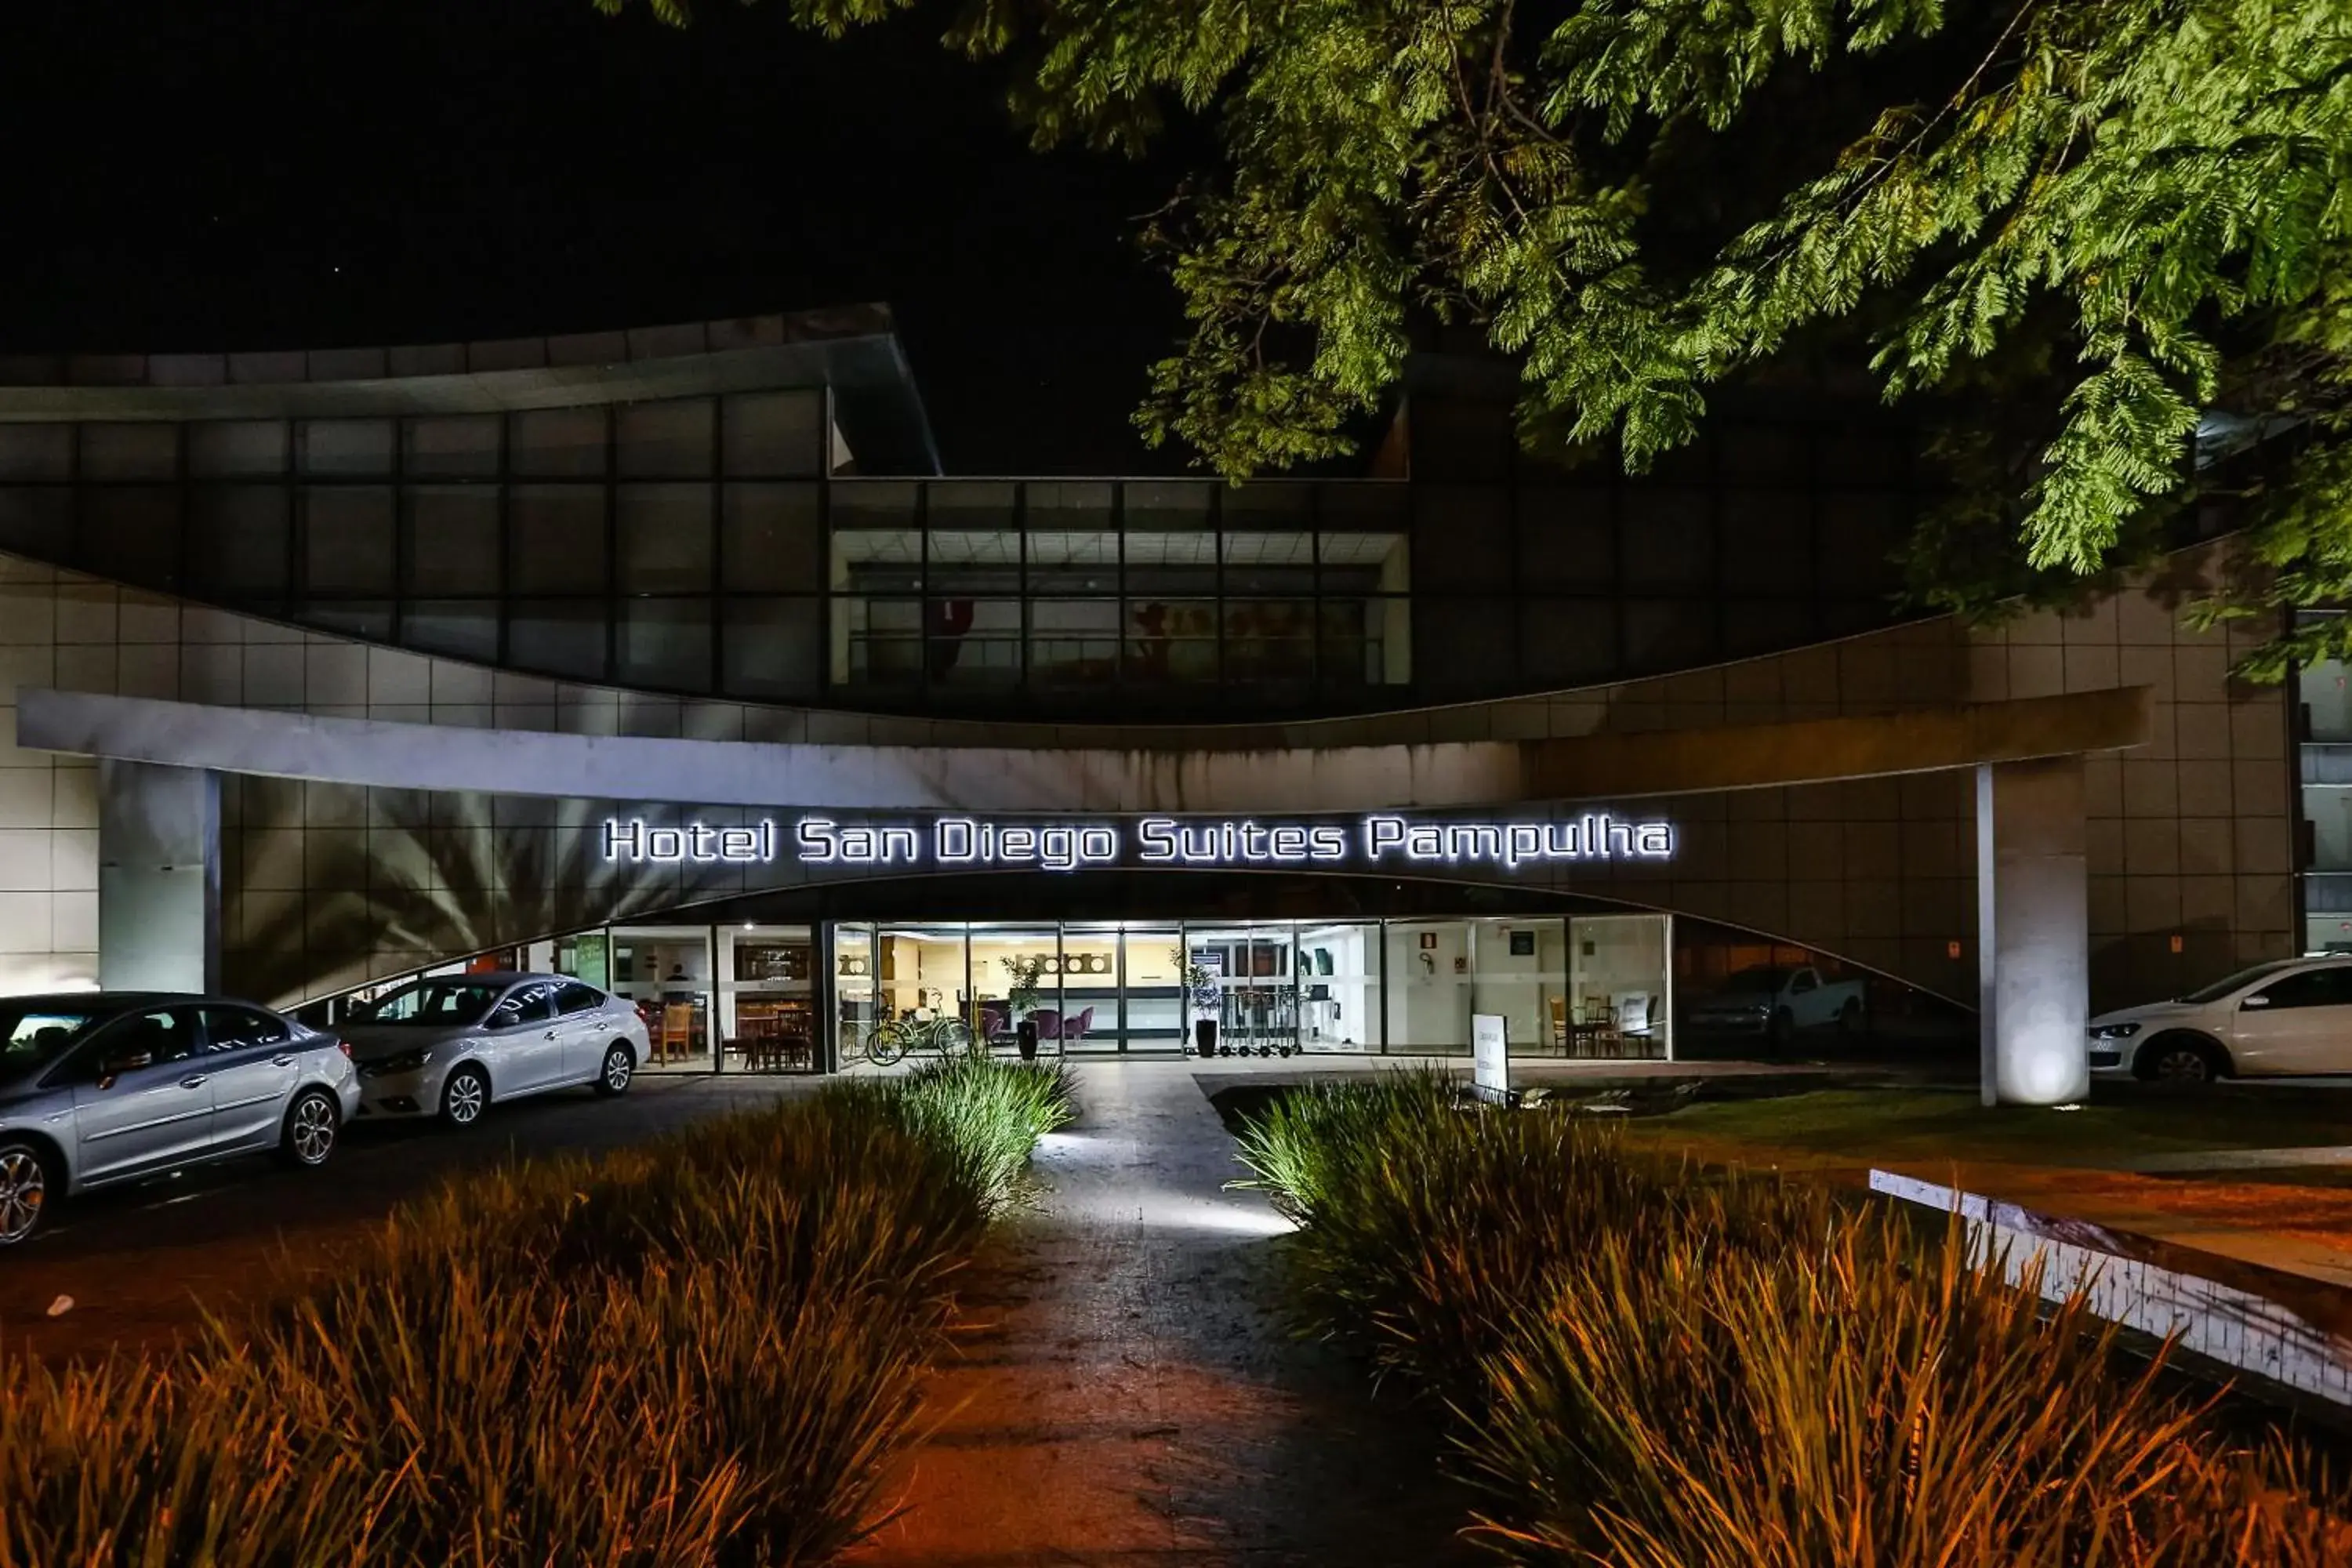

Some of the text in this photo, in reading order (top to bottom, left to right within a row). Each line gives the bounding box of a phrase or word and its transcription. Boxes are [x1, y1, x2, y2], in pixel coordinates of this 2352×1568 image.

[604, 816, 1671, 869] Hotel San Diego Suites Pampulha
